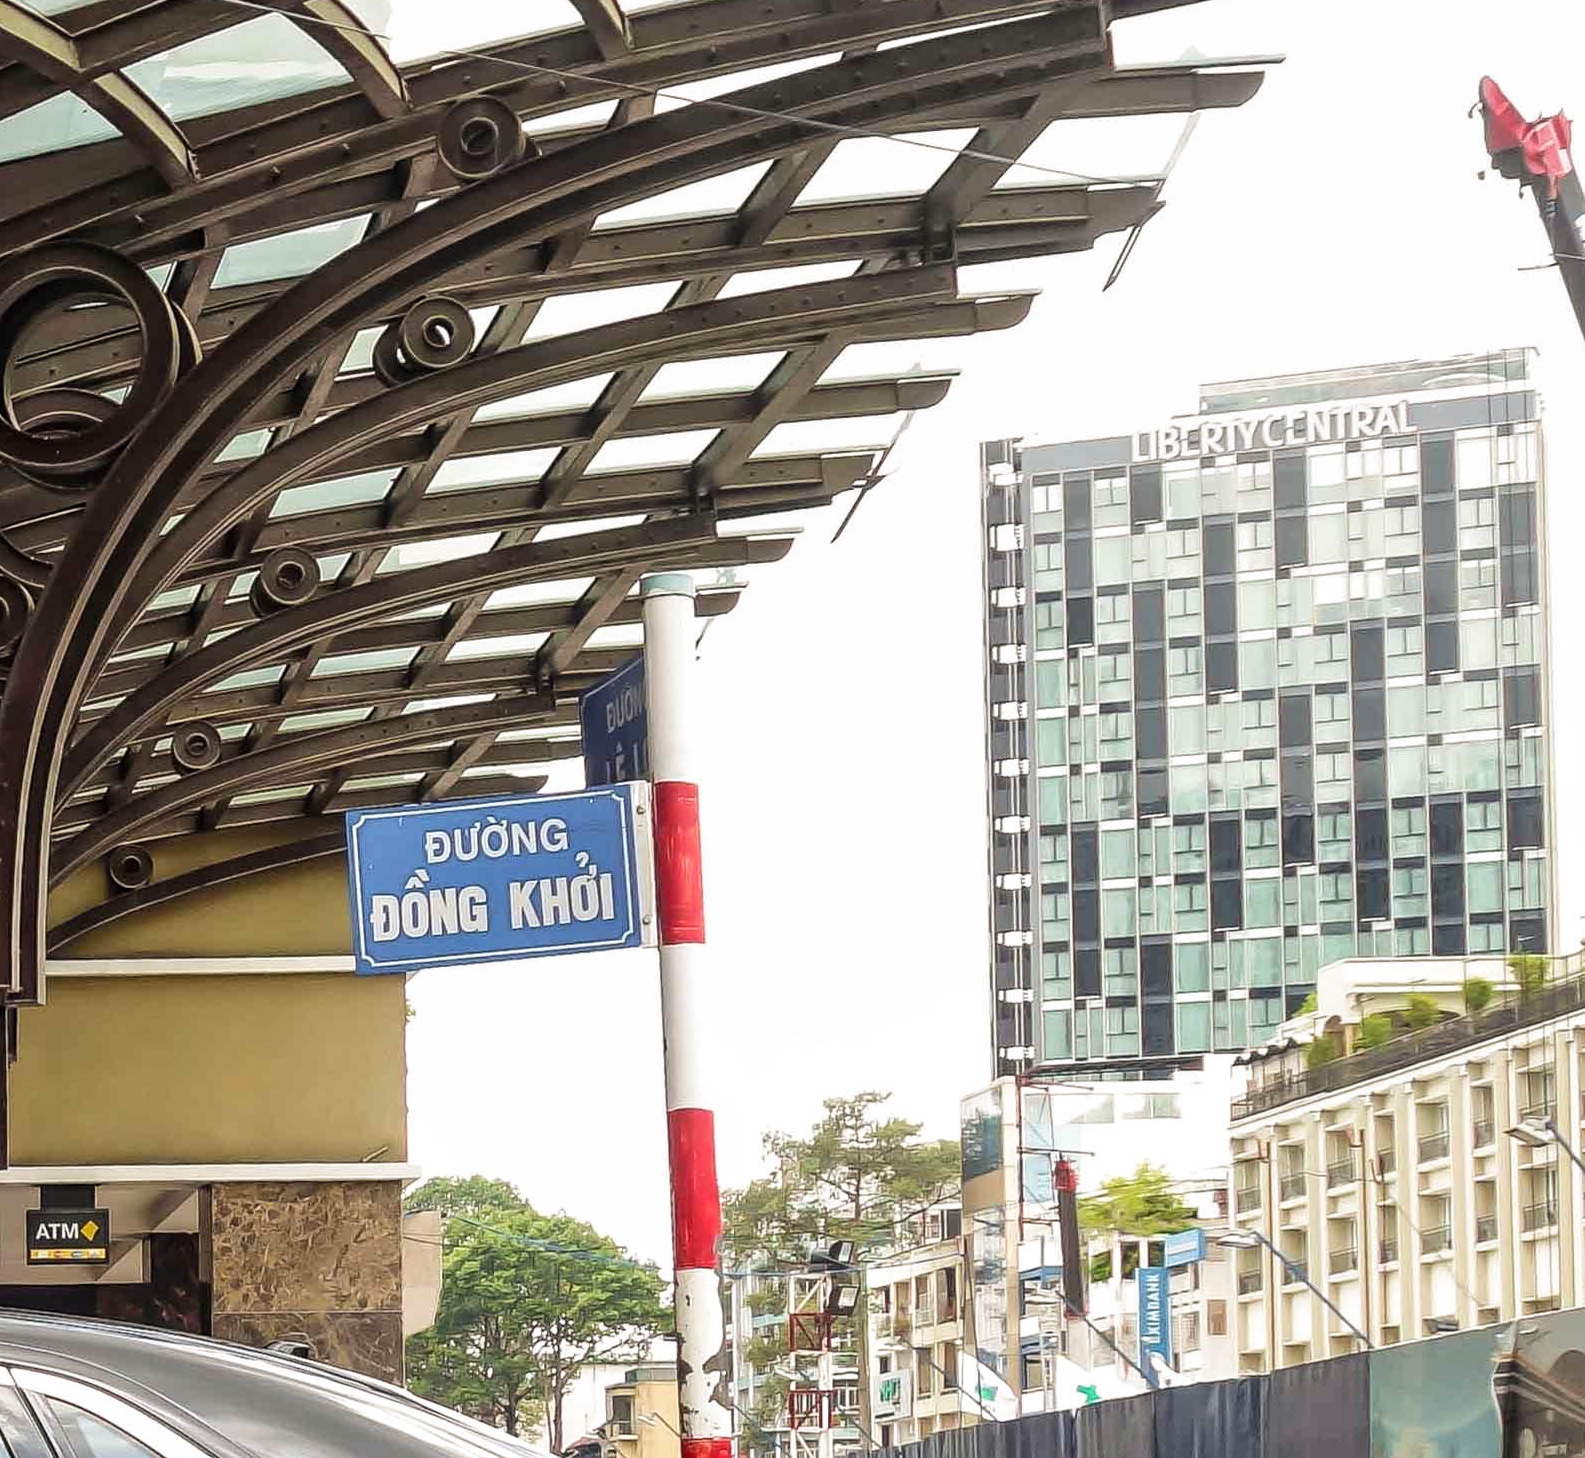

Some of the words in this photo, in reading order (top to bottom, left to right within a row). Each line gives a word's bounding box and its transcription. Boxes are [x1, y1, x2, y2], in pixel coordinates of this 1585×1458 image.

[424, 816, 569, 865] ĐƯỜNG
[370, 868, 489, 943] ĐỒNG
[509, 851, 616, 930] KHỞI
[35, 1223, 80, 1241] ATM
